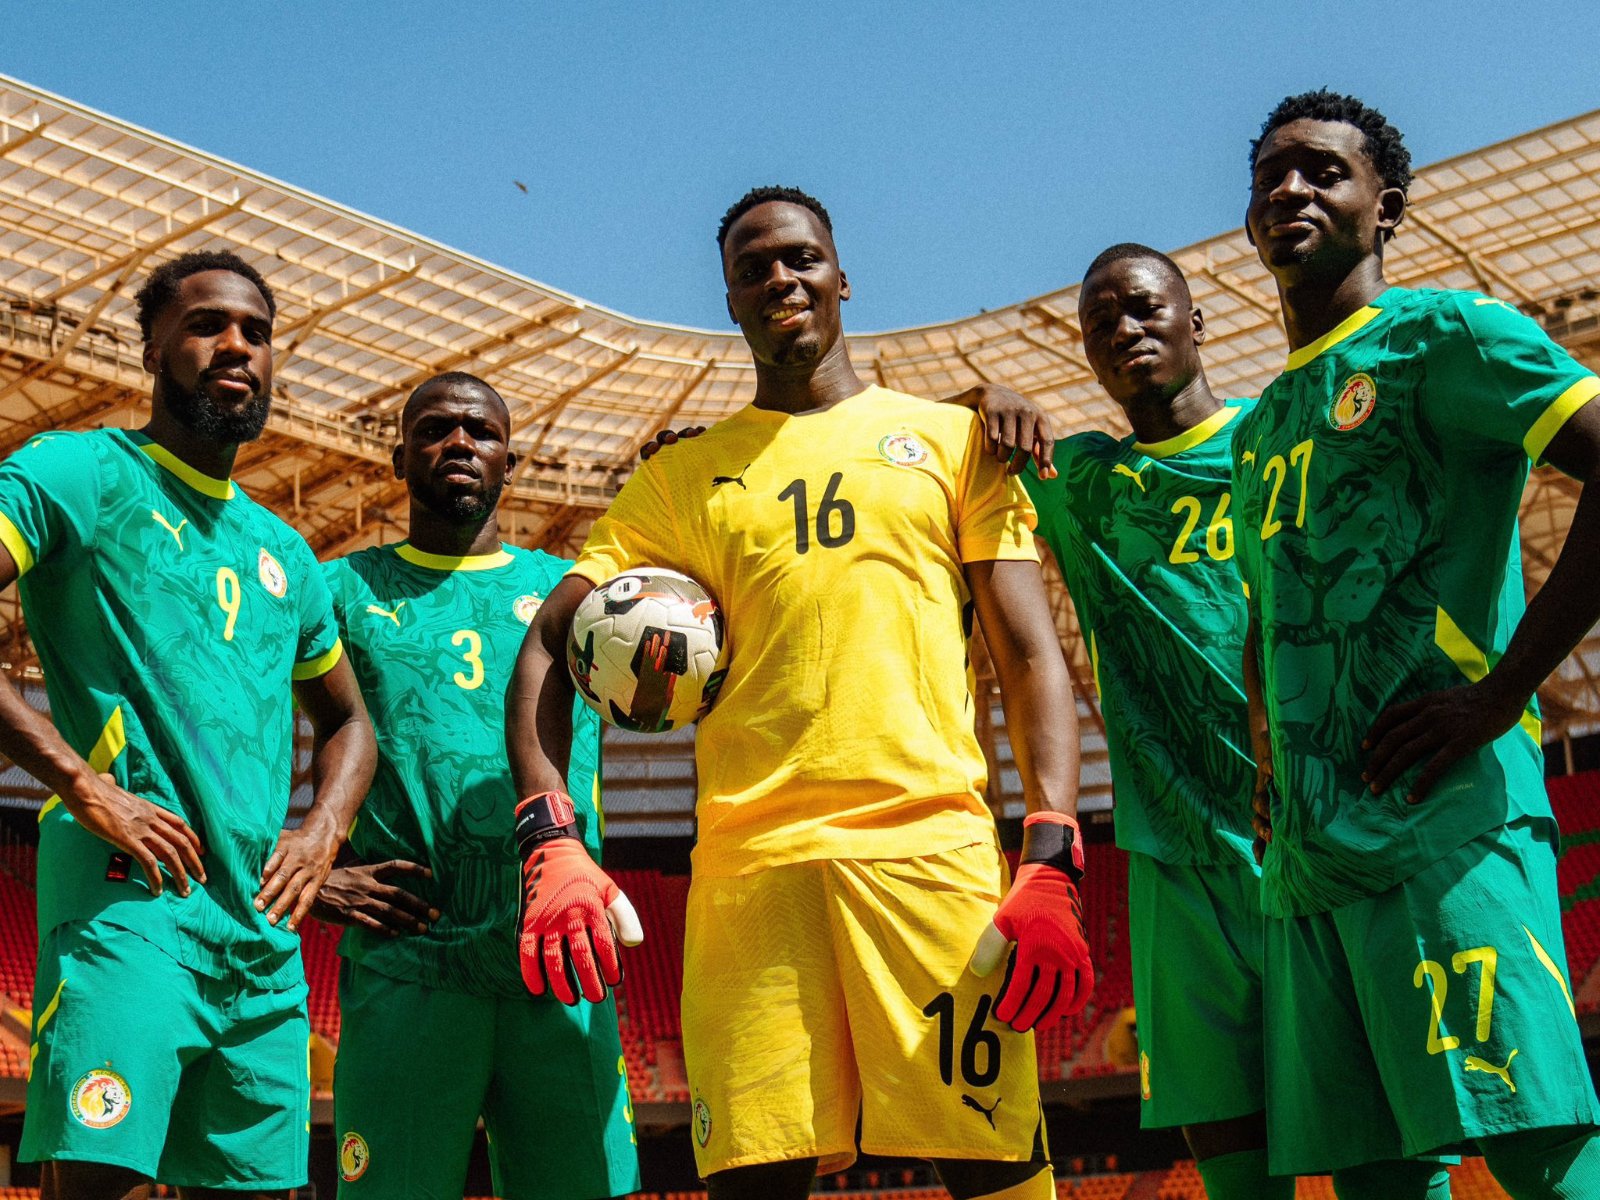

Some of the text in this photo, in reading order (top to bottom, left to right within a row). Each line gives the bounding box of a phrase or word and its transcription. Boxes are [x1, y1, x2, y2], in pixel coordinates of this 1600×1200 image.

[777, 471, 856, 555] 16
[1168, 492, 1235, 564] 26
[1260, 439, 1314, 541] 27
[217, 567, 241, 641] 9
[452, 629, 484, 690] 3
[923, 992, 1002, 1087] 16
[1413, 946, 1497, 1055] 27
